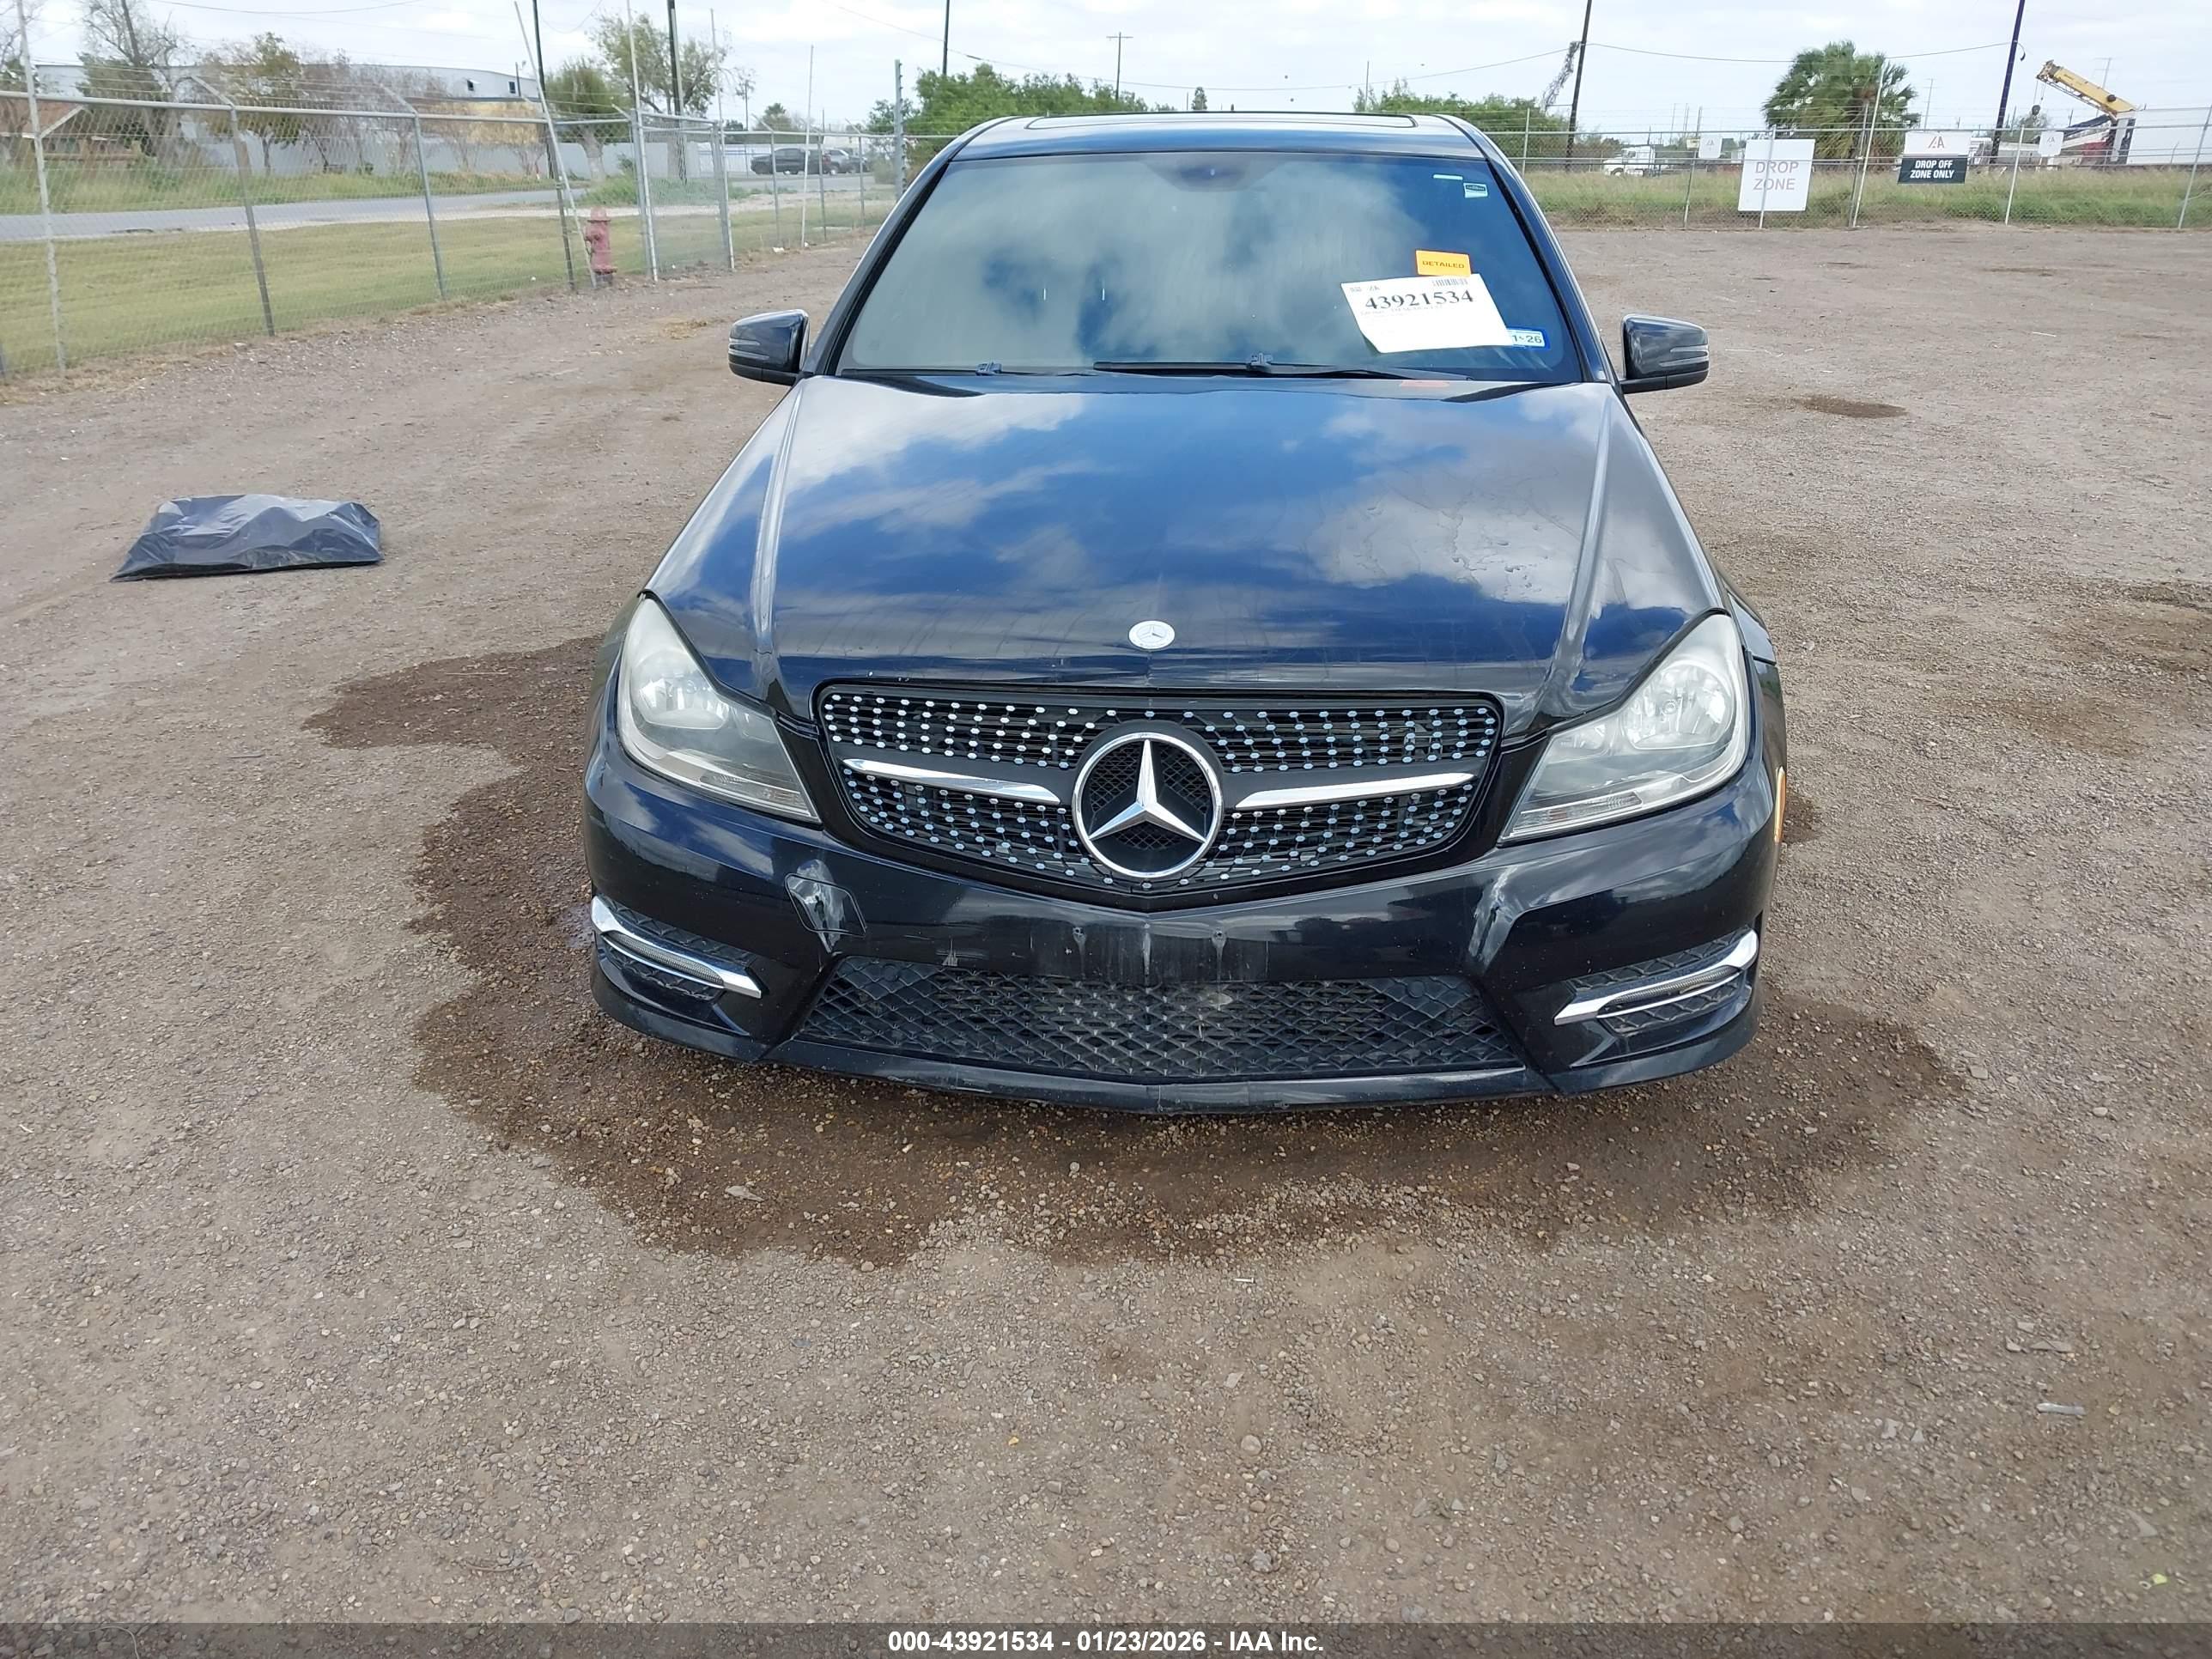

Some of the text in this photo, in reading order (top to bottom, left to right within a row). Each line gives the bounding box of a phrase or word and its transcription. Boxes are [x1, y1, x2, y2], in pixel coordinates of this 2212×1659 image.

[1755, 161, 1799, 173] DROP
[1914, 160, 1954, 169] DROP OFF
[1909, 169, 1955, 179] ZONE ONLY
[1753, 178, 1796, 191] ZONE
[1422, 260, 1465, 269] DETAILED
[1365, 289, 1474, 309] 43921534
